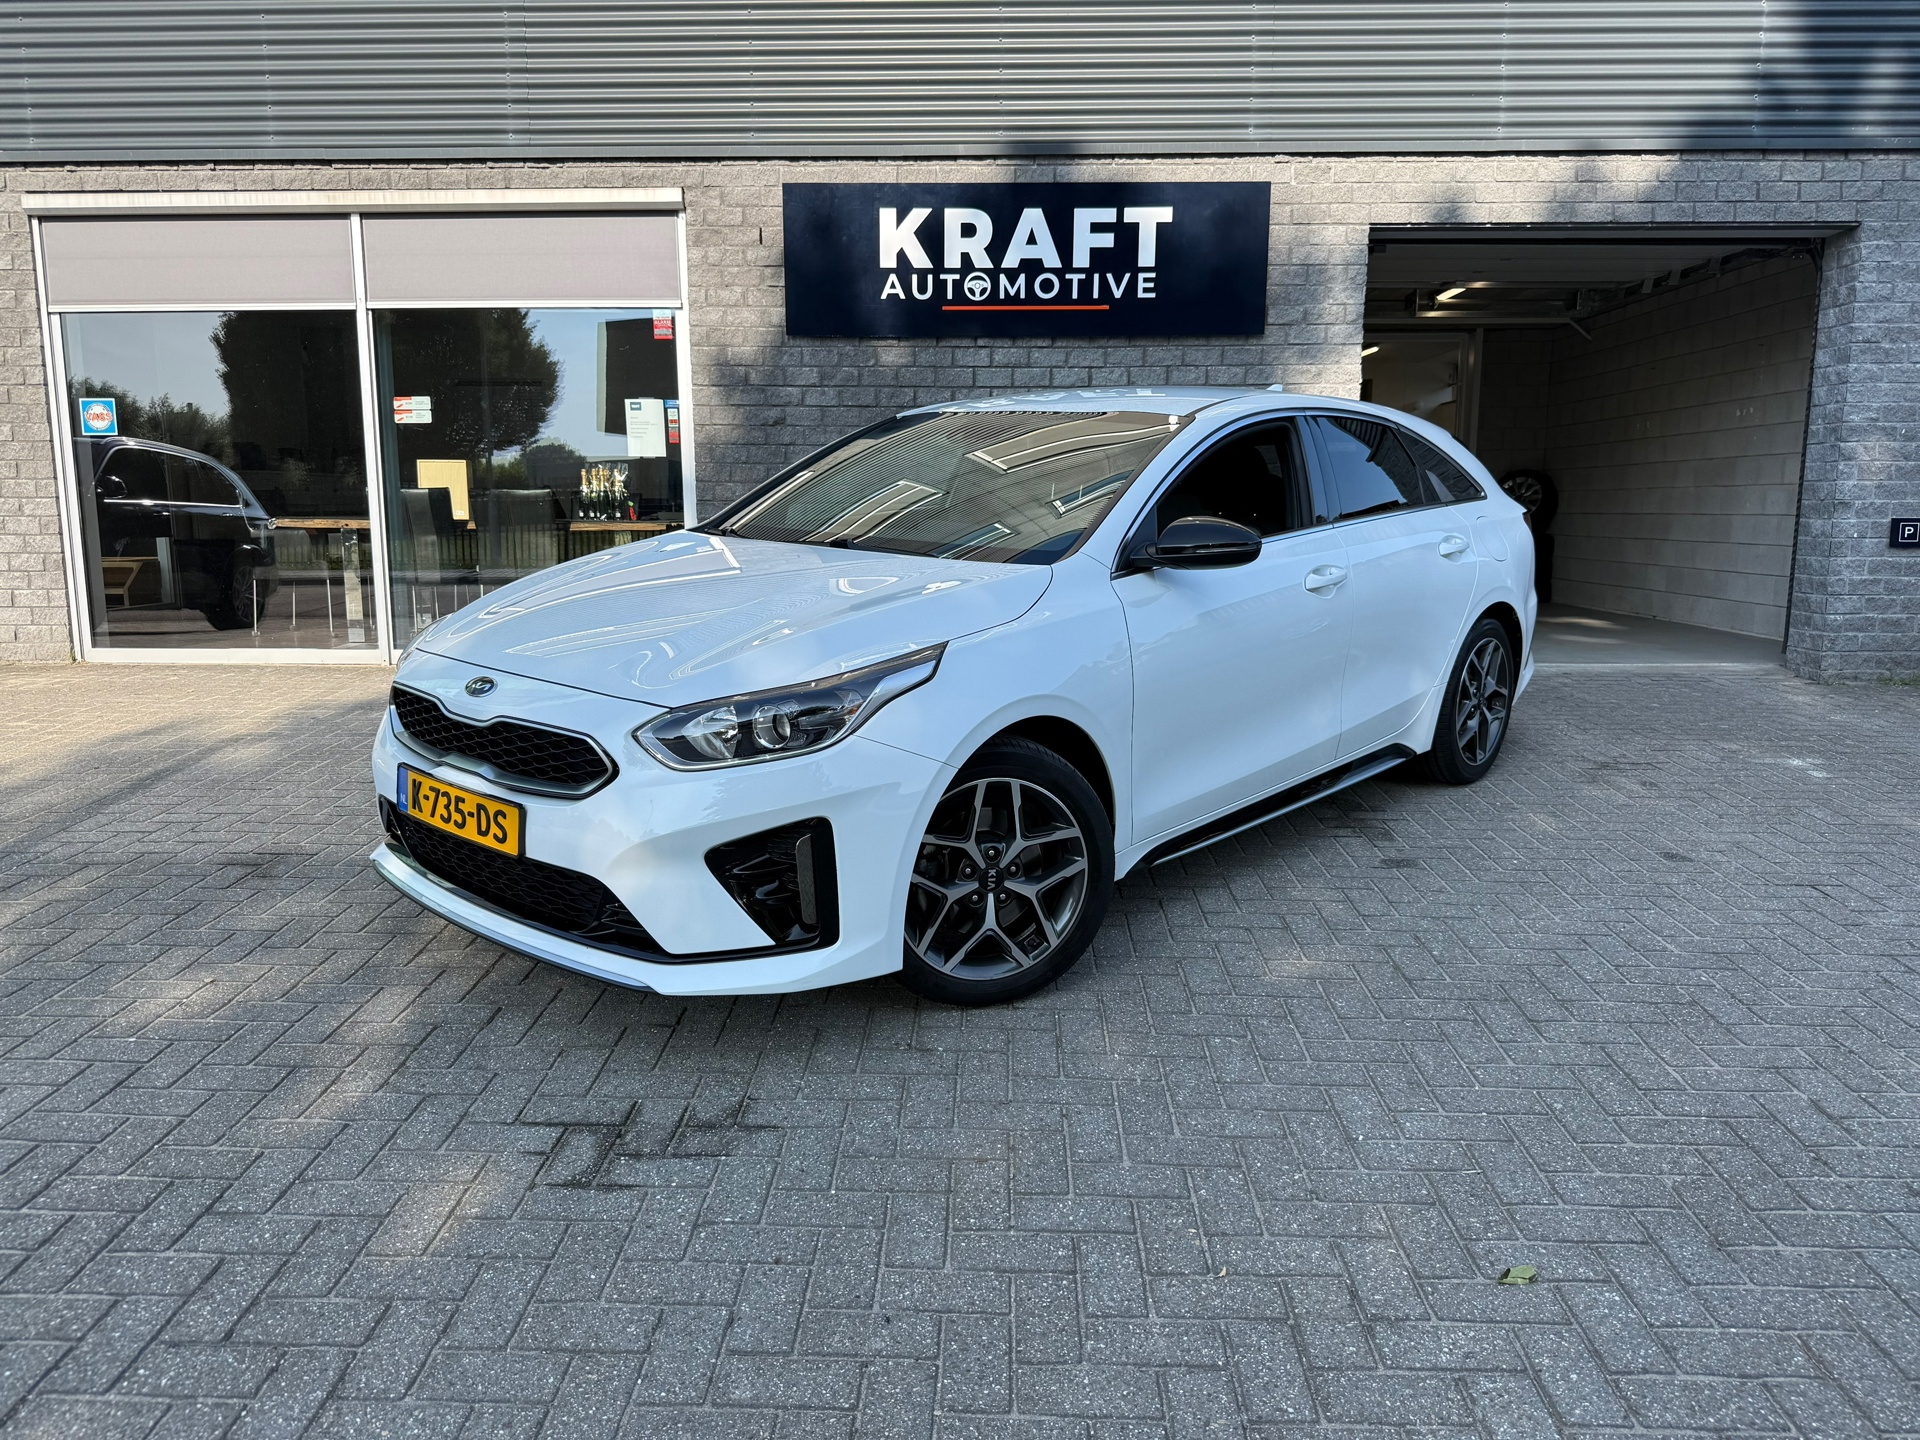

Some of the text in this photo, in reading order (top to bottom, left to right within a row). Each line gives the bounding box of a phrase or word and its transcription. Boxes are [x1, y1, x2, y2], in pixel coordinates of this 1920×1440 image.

[879, 206, 1174, 269] KRAFT
[880, 271, 1157, 301] AUTOMOTIVE
[1904, 526, 1914, 538] P
[400, 792, 408, 805] NL
[411, 778, 508, 845] K-735-DS
[987, 869, 997, 890] KIA
